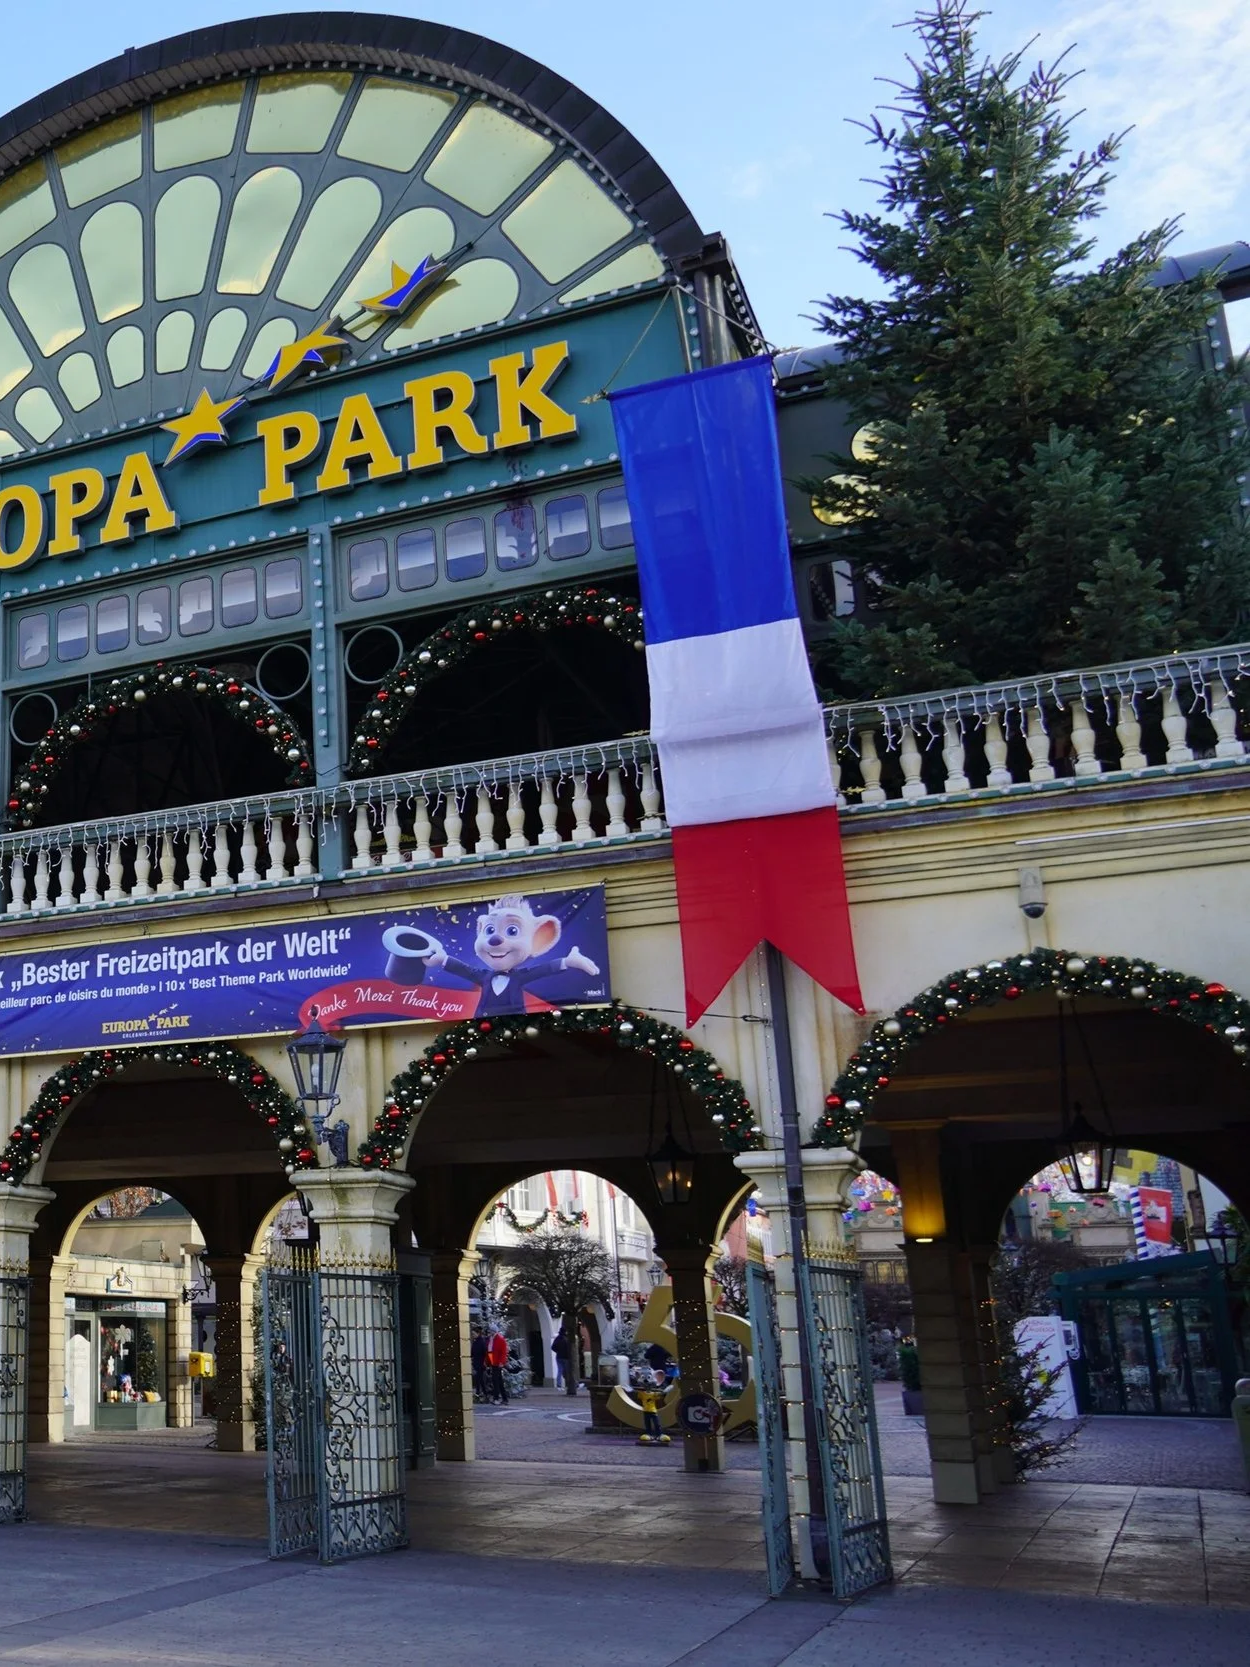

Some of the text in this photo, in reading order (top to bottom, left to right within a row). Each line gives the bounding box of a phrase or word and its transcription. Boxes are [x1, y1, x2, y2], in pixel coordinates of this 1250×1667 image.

[257, 340, 579, 507] PARK
[96, 941, 230, 978] Freizeitpark
[237, 938, 277, 964] der
[30, 994, 53, 1008] parc
[55, 991, 66, 1003] de
[68, 988, 98, 1002] loisirs
[100, 986, 113, 998] du
[165, 980, 178, 992] 10
[178, 981, 186, 991] x
[219, 972, 256, 987] Theme
[258, 970, 285, 984] Park
[354, 987, 395, 1003] Merci
[401, 989, 439, 1011] Thank
[437, 1002, 464, 1018] you
[102, 1015, 190, 1034] EUROPA PARK
